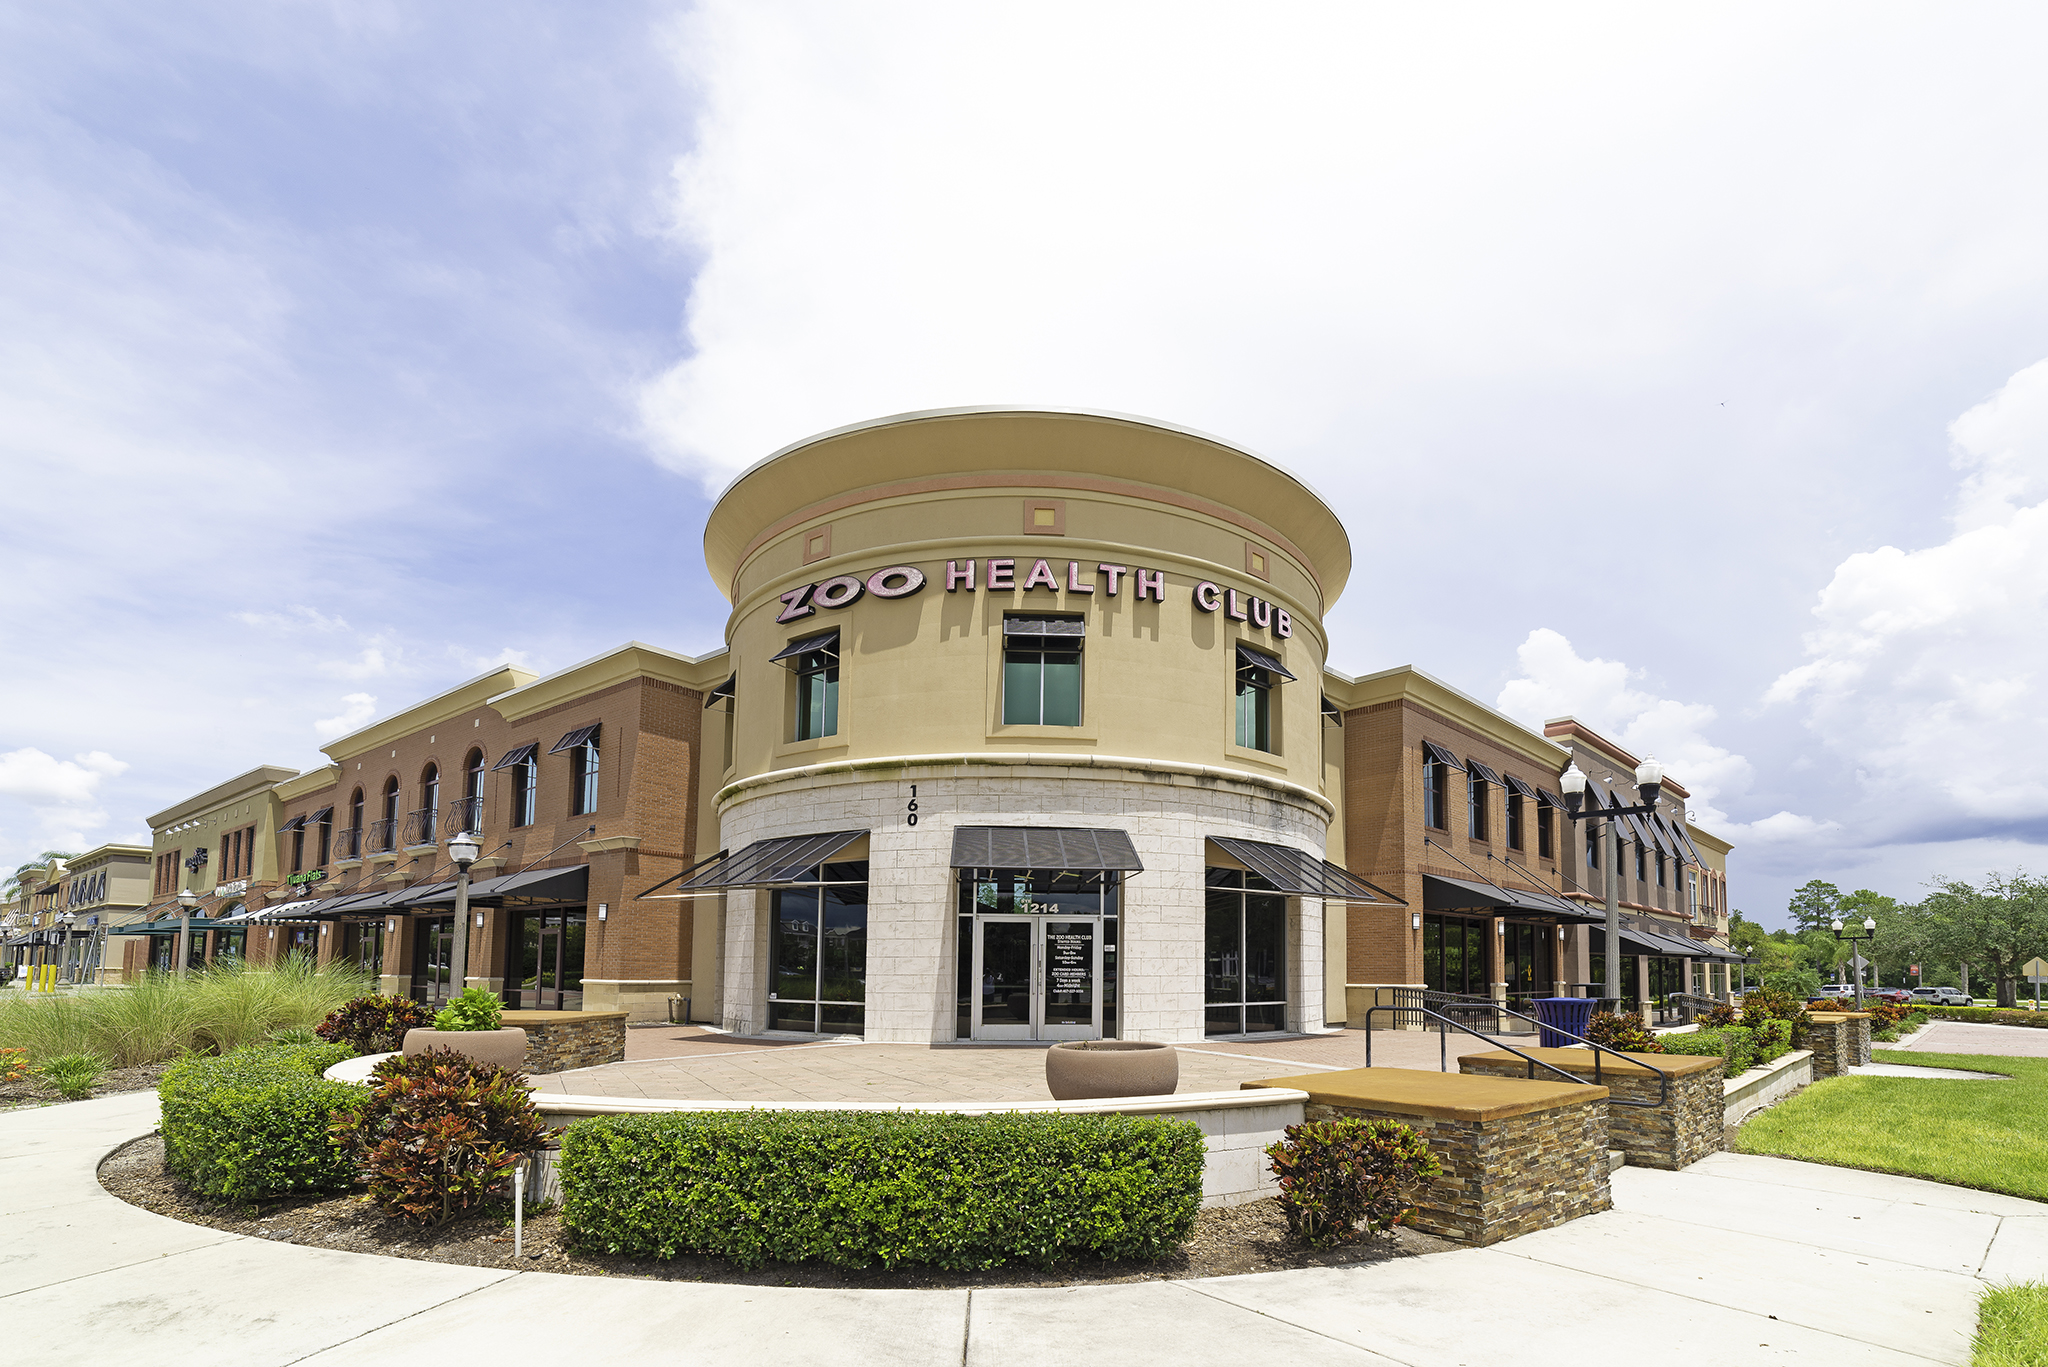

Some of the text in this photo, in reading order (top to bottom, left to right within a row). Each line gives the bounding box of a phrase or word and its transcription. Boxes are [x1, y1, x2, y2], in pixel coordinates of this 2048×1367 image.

[776, 558, 1293, 639] ZOO HEALTH CLUB
[907, 784, 918, 826] 160
[287, 869, 322, 886] Tijuana Flats
[1020, 903, 1059, 914] 1214
